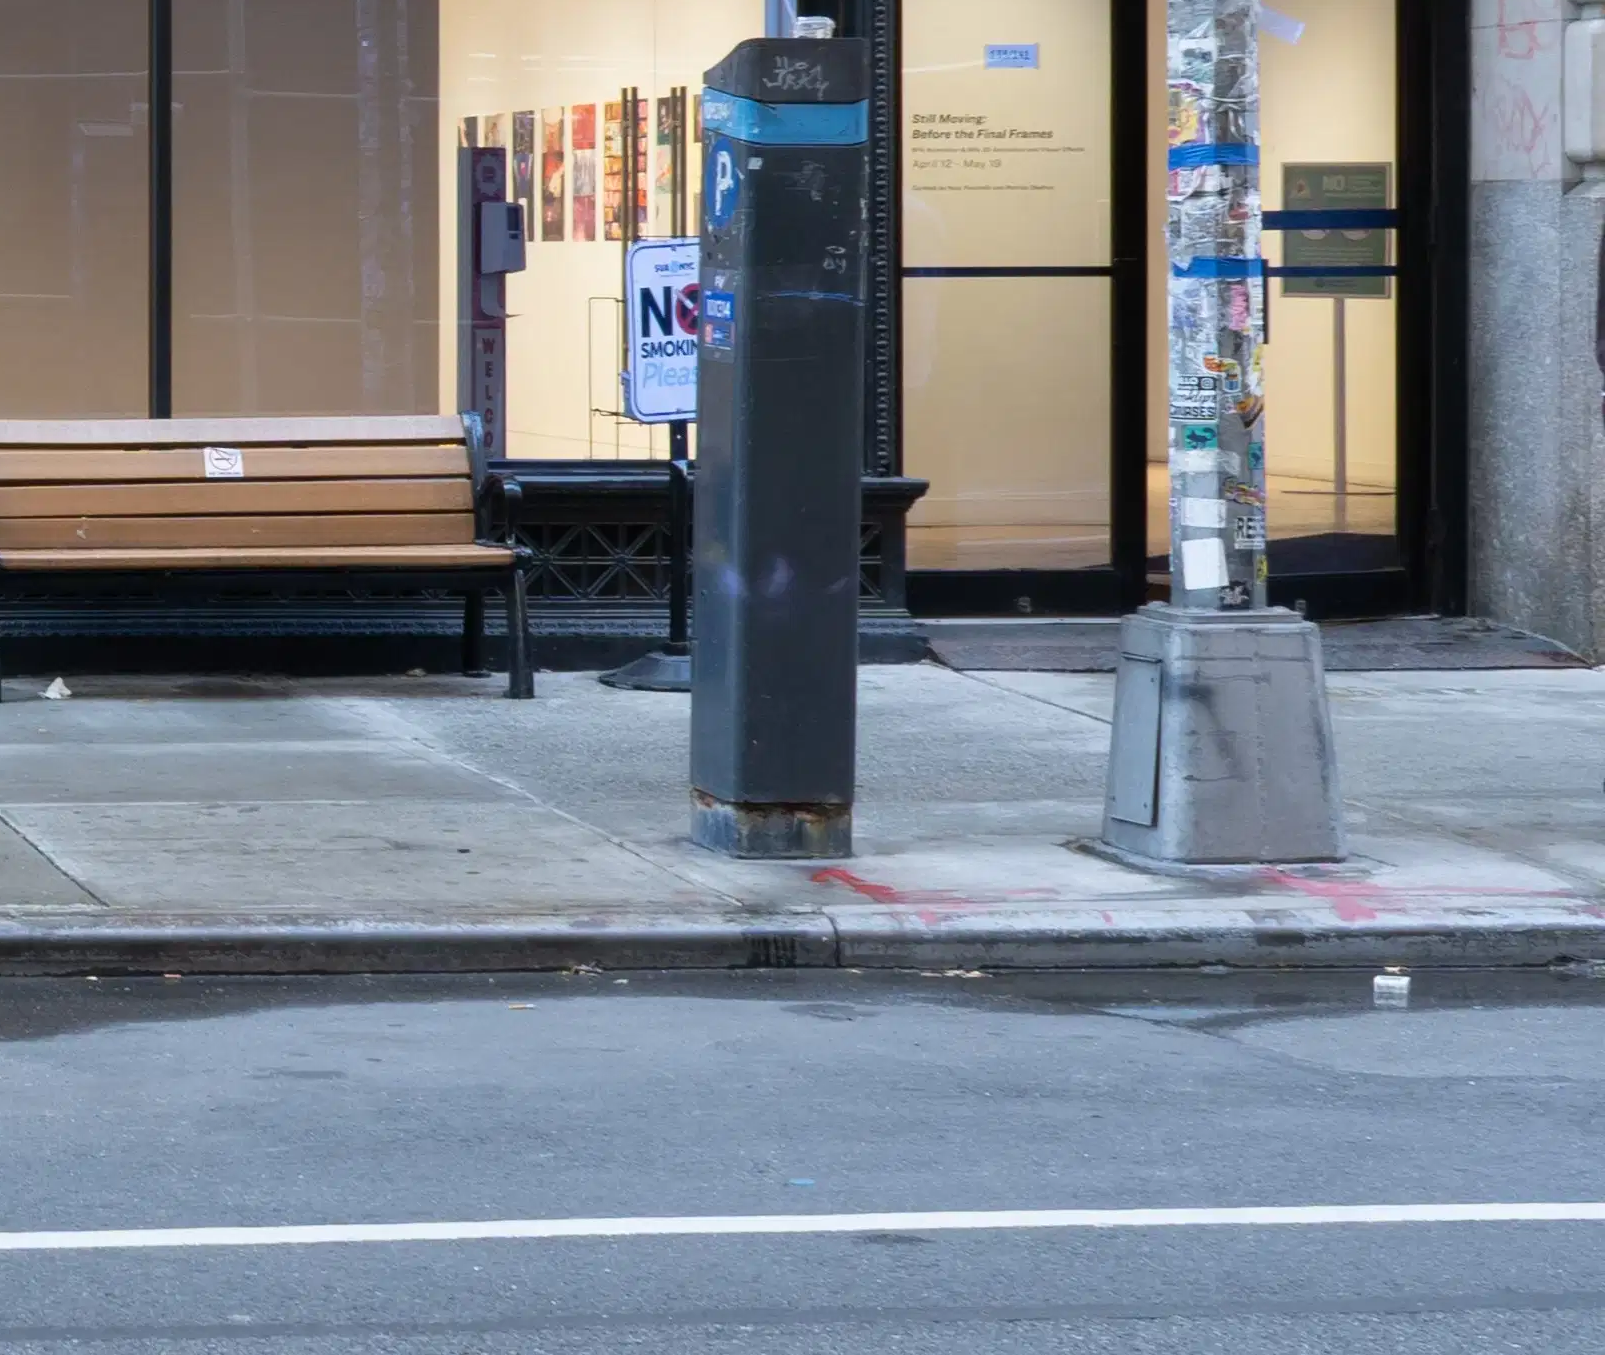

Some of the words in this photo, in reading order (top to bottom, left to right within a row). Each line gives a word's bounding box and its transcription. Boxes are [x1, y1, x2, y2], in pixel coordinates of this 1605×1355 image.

[911, 114, 937, 124] Still
[911, 129, 952, 139] Before
[954, 129, 974, 139] the
[976, 129, 1007, 139] Final
[1008, 129, 1054, 139] Frames
[912, 158, 938, 169] April
[963, 159, 986, 169] May
[641, 339, 698, 358] SMOKIN
[643, 362, 698, 388] Pleas
